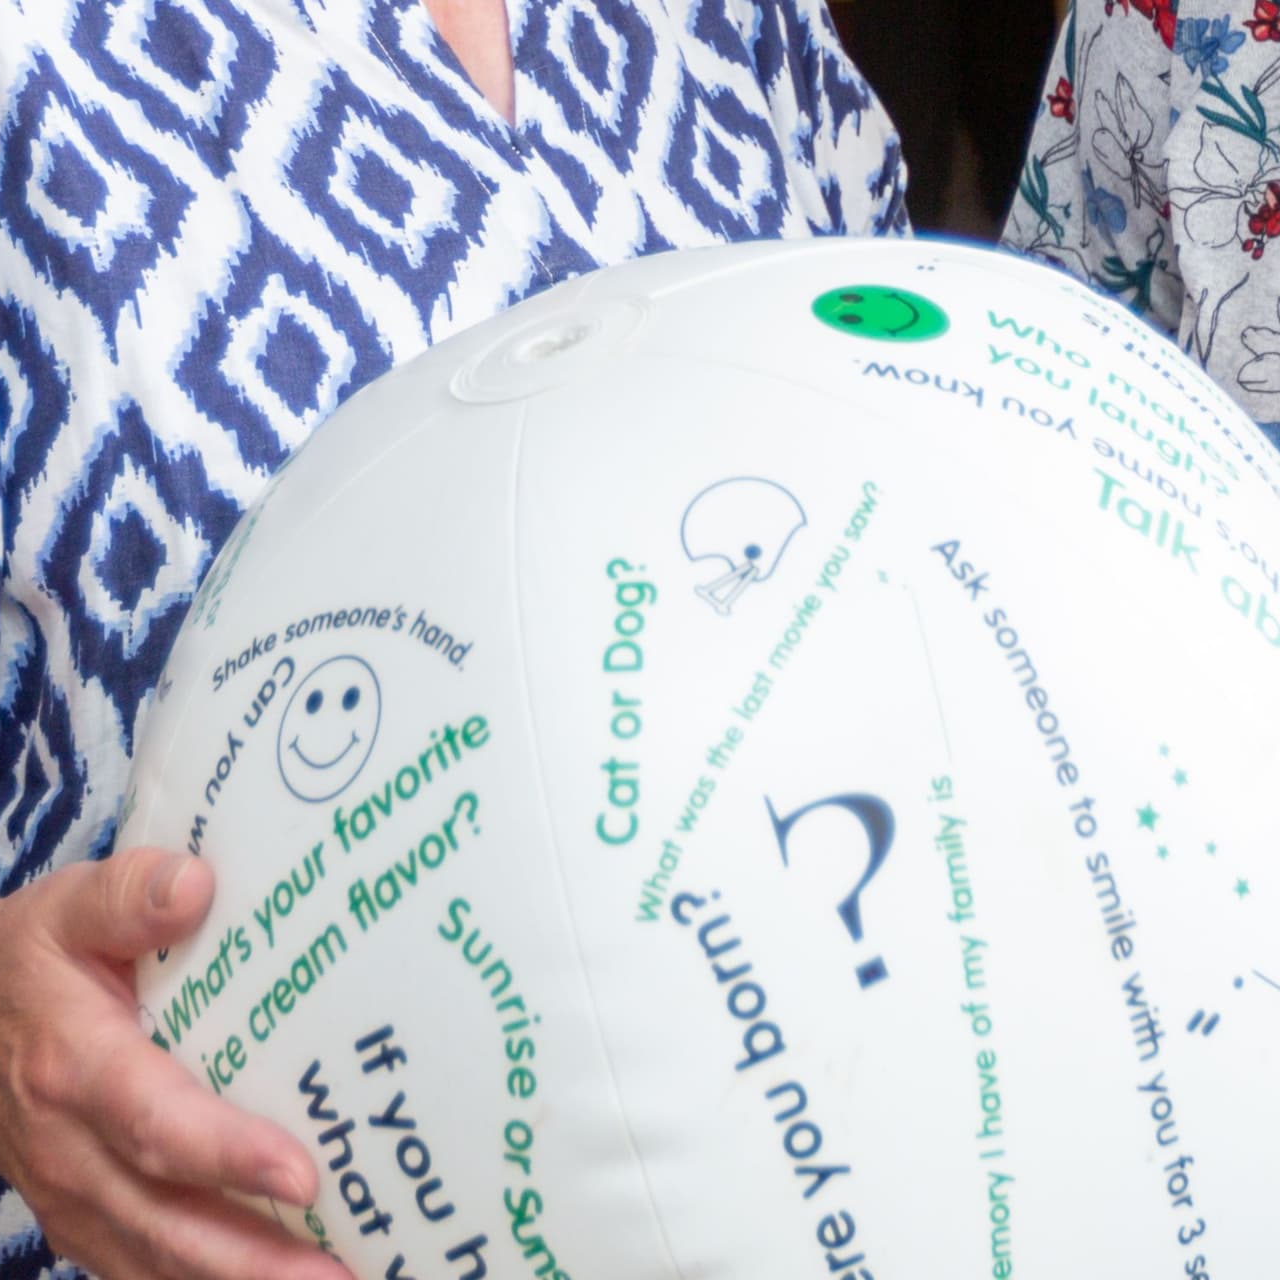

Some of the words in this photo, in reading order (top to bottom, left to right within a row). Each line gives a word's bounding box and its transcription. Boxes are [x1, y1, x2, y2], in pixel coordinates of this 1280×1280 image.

[987, 310, 1091, 368] Who
[1107, 372, 1239, 480] makes
[988, 344, 1072, 390] you
[1088, 387, 1229, 495] laugh?
[1001, 397, 1077, 440] you
[1092, 437, 1202, 518] name
[1092, 465, 1200, 576] Talk
[602, 557, 658, 674] Dog?
[930, 539, 989, 602] Ask
[212, 632, 278, 692] shake
[285, 605, 408, 643] someone's
[243, 656, 296, 728] Can
[609, 689, 643, 741] or
[635, 839, 682, 923] What
[675, 776, 716, 833] was
[705, 727, 744, 770] the
[731, 671, 773, 722] last
[768, 594, 822, 670] movie
[816, 545, 851, 592] you
[843, 480, 883, 542] saw?
[984, 608, 1079, 787] someone
[204, 730, 245, 807] you
[594, 756, 640, 848] Cat
[926, 774, 954, 803] is
[1069, 796, 1098, 839] to
[163, 926, 252, 1047] What's
[252, 840, 326, 950] your
[332, 715, 491, 855] favorite
[933, 813, 976, 926] family
[1085, 851, 1136, 962] smile
[201, 1034, 247, 1102] ice
[248, 923, 348, 1043] cream
[347, 790, 481, 933] flavor?
[669, 889, 788, 1069] born?
[959, 934, 989, 992] my
[353, 1024, 408, 1076] If
[437, 897, 542, 1099] Sunrise
[502, 1118, 534, 1177] or
[960, 1001, 993, 1038] of
[1121, 972, 1166, 1063] with
[975, 1048, 1004, 1140] have
[1136, 1072, 1179, 1148] you
[297, 1058, 394, 1237] what
[367, 1090, 456, 1224] you
[764, 1079, 852, 1201] you
[978, 1148, 1007, 1162] I
[1163, 1155, 1194, 1208] for
[1177, 1217, 1207, 1247] 3
